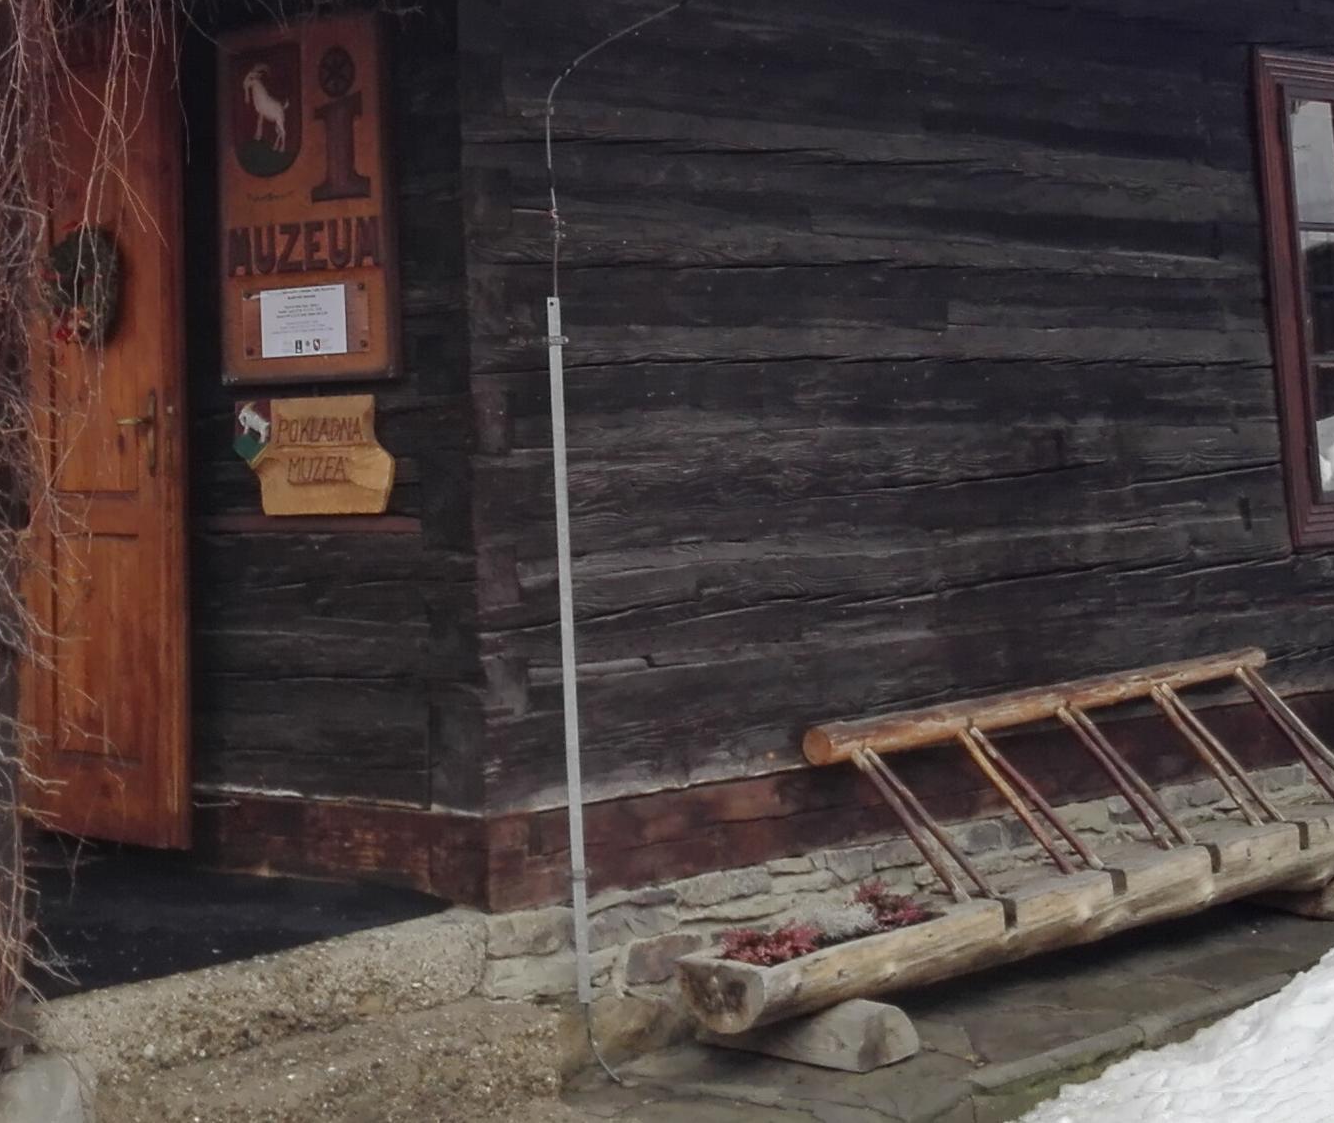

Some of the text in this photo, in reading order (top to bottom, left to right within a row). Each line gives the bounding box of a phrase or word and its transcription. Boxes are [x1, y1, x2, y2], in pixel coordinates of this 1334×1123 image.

[228, 214, 381, 276] MUZEUM
[276, 415, 364, 445] POKLADNA
[287, 455, 348, 483] MUZEA
